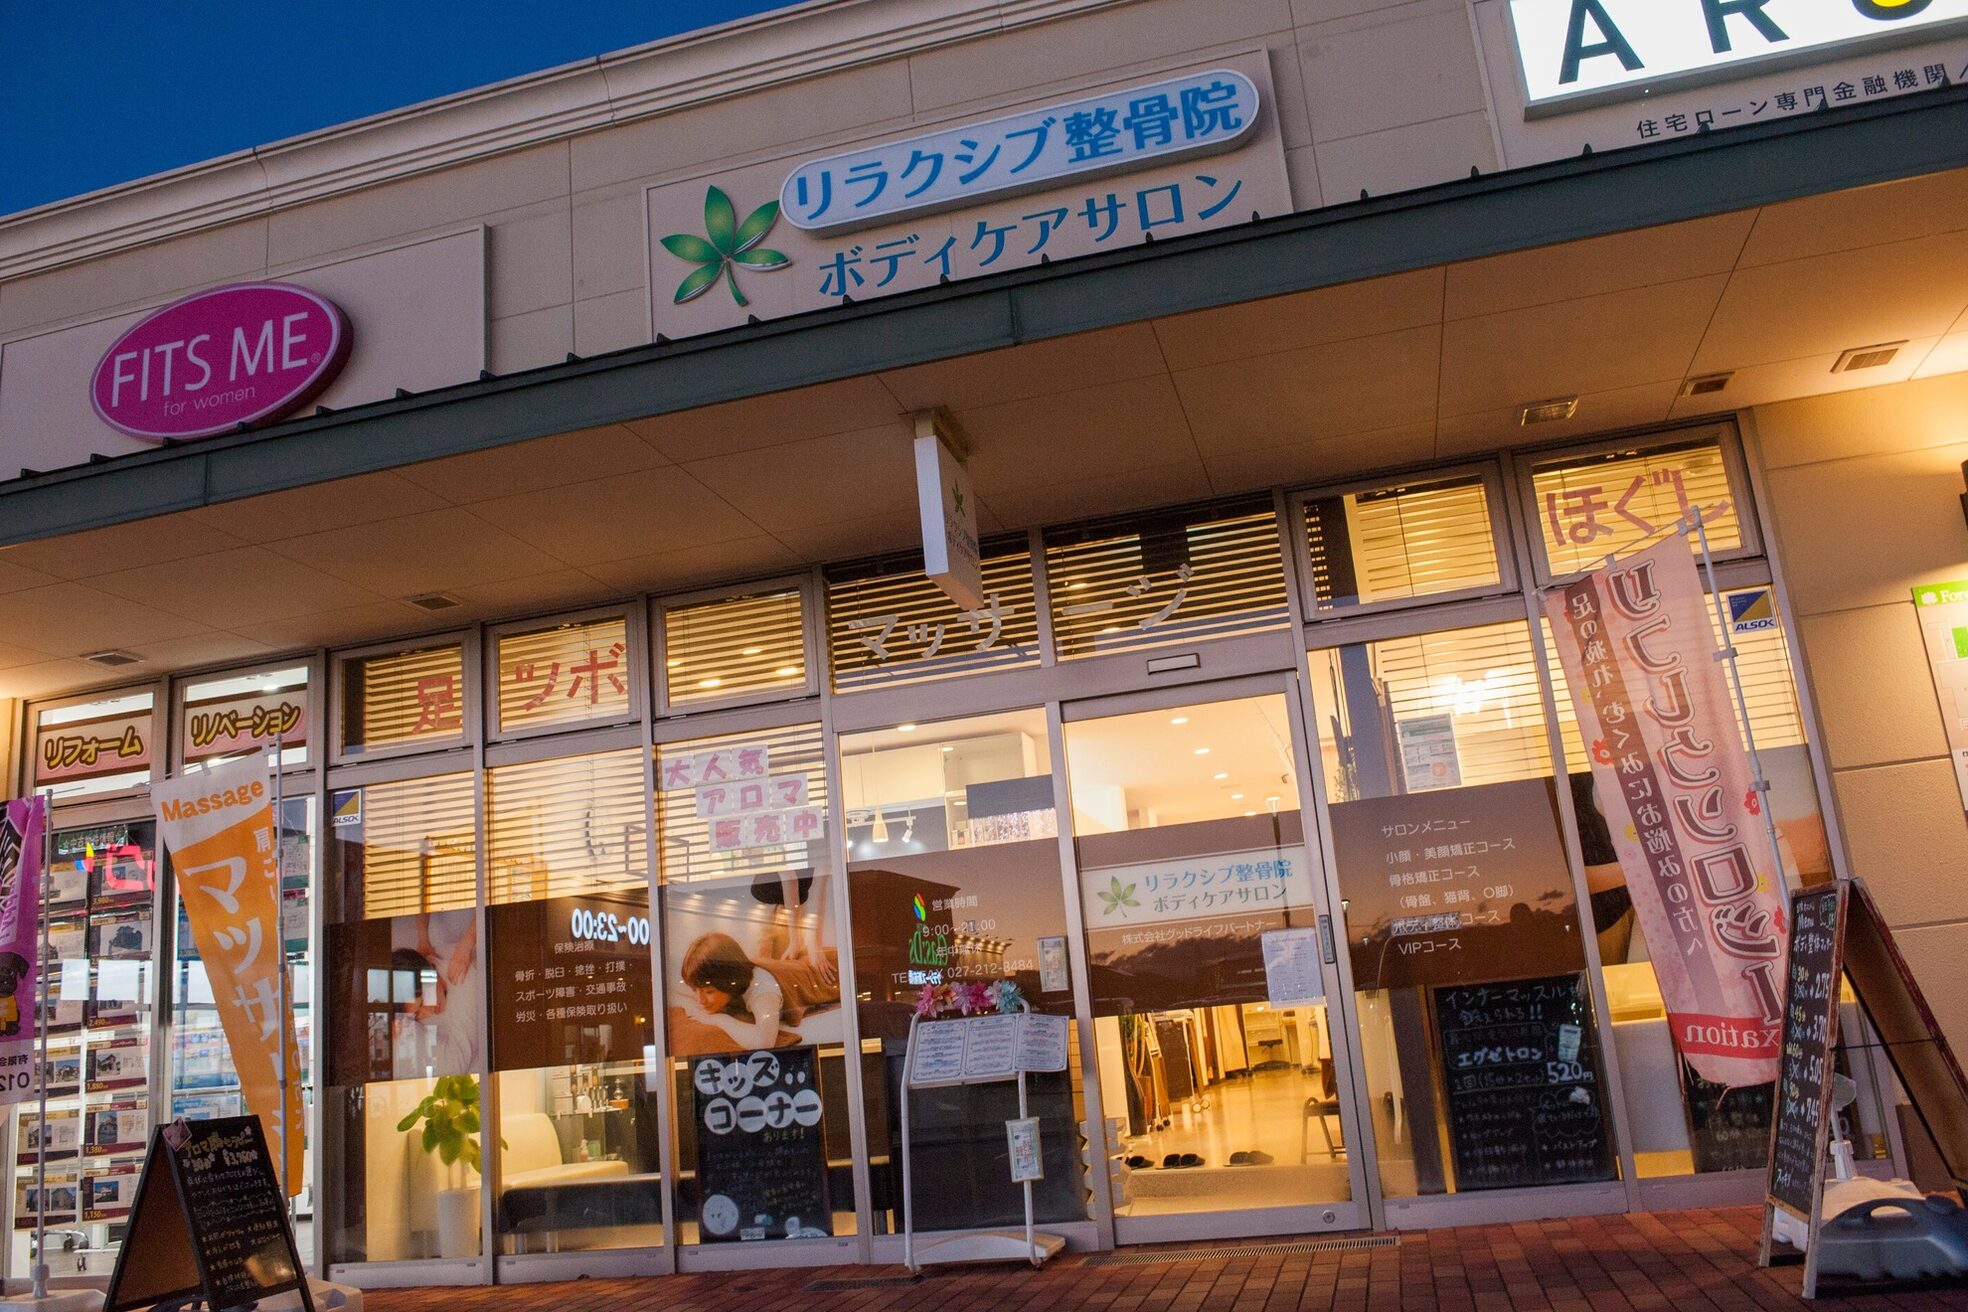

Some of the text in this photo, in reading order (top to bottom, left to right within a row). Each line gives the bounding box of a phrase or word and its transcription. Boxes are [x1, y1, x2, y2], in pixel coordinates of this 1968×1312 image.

[796, 81, 1243, 222] リラクシブ整骨院
[818, 174, 1243, 298] ボディケアサロン
[111, 311, 309, 408] FITS ME
[163, 385, 256, 419] for women
[1547, 468, 1730, 546] ほぐし
[1735, 618, 1777, 632] ALSOK
[190, 701, 302, 746] リノベーション
[45, 727, 145, 769] リフォーム
[664, 748, 765, 787] 大人気
[161, 780, 265, 823] Massage
[702, 780, 803, 814] アロマ
[333, 815, 359, 825] ALSOK
[715, 810, 819, 847] 販売中
[1381, 820, 1471, 837] サロンメニュー
[1385, 838, 1516, 865] 小顔・美顔矯正コース
[1145, 858, 1293, 892] リラクシブ整骨院
[1389, 865, 1480, 888] 骨格矯正コース
[932, 895, 978, 912] 営業時間
[1153, 883, 1287, 914] ボディケアサロン
[554, 940, 594, 954] 保険治療
[1398, 939, 1462, 956] VIPコース
[947, 958, 1033, 980] 027-212-8484
[699, 1055, 779, 1092] キッズ
[711, 1096, 818, 1130] コーナー
